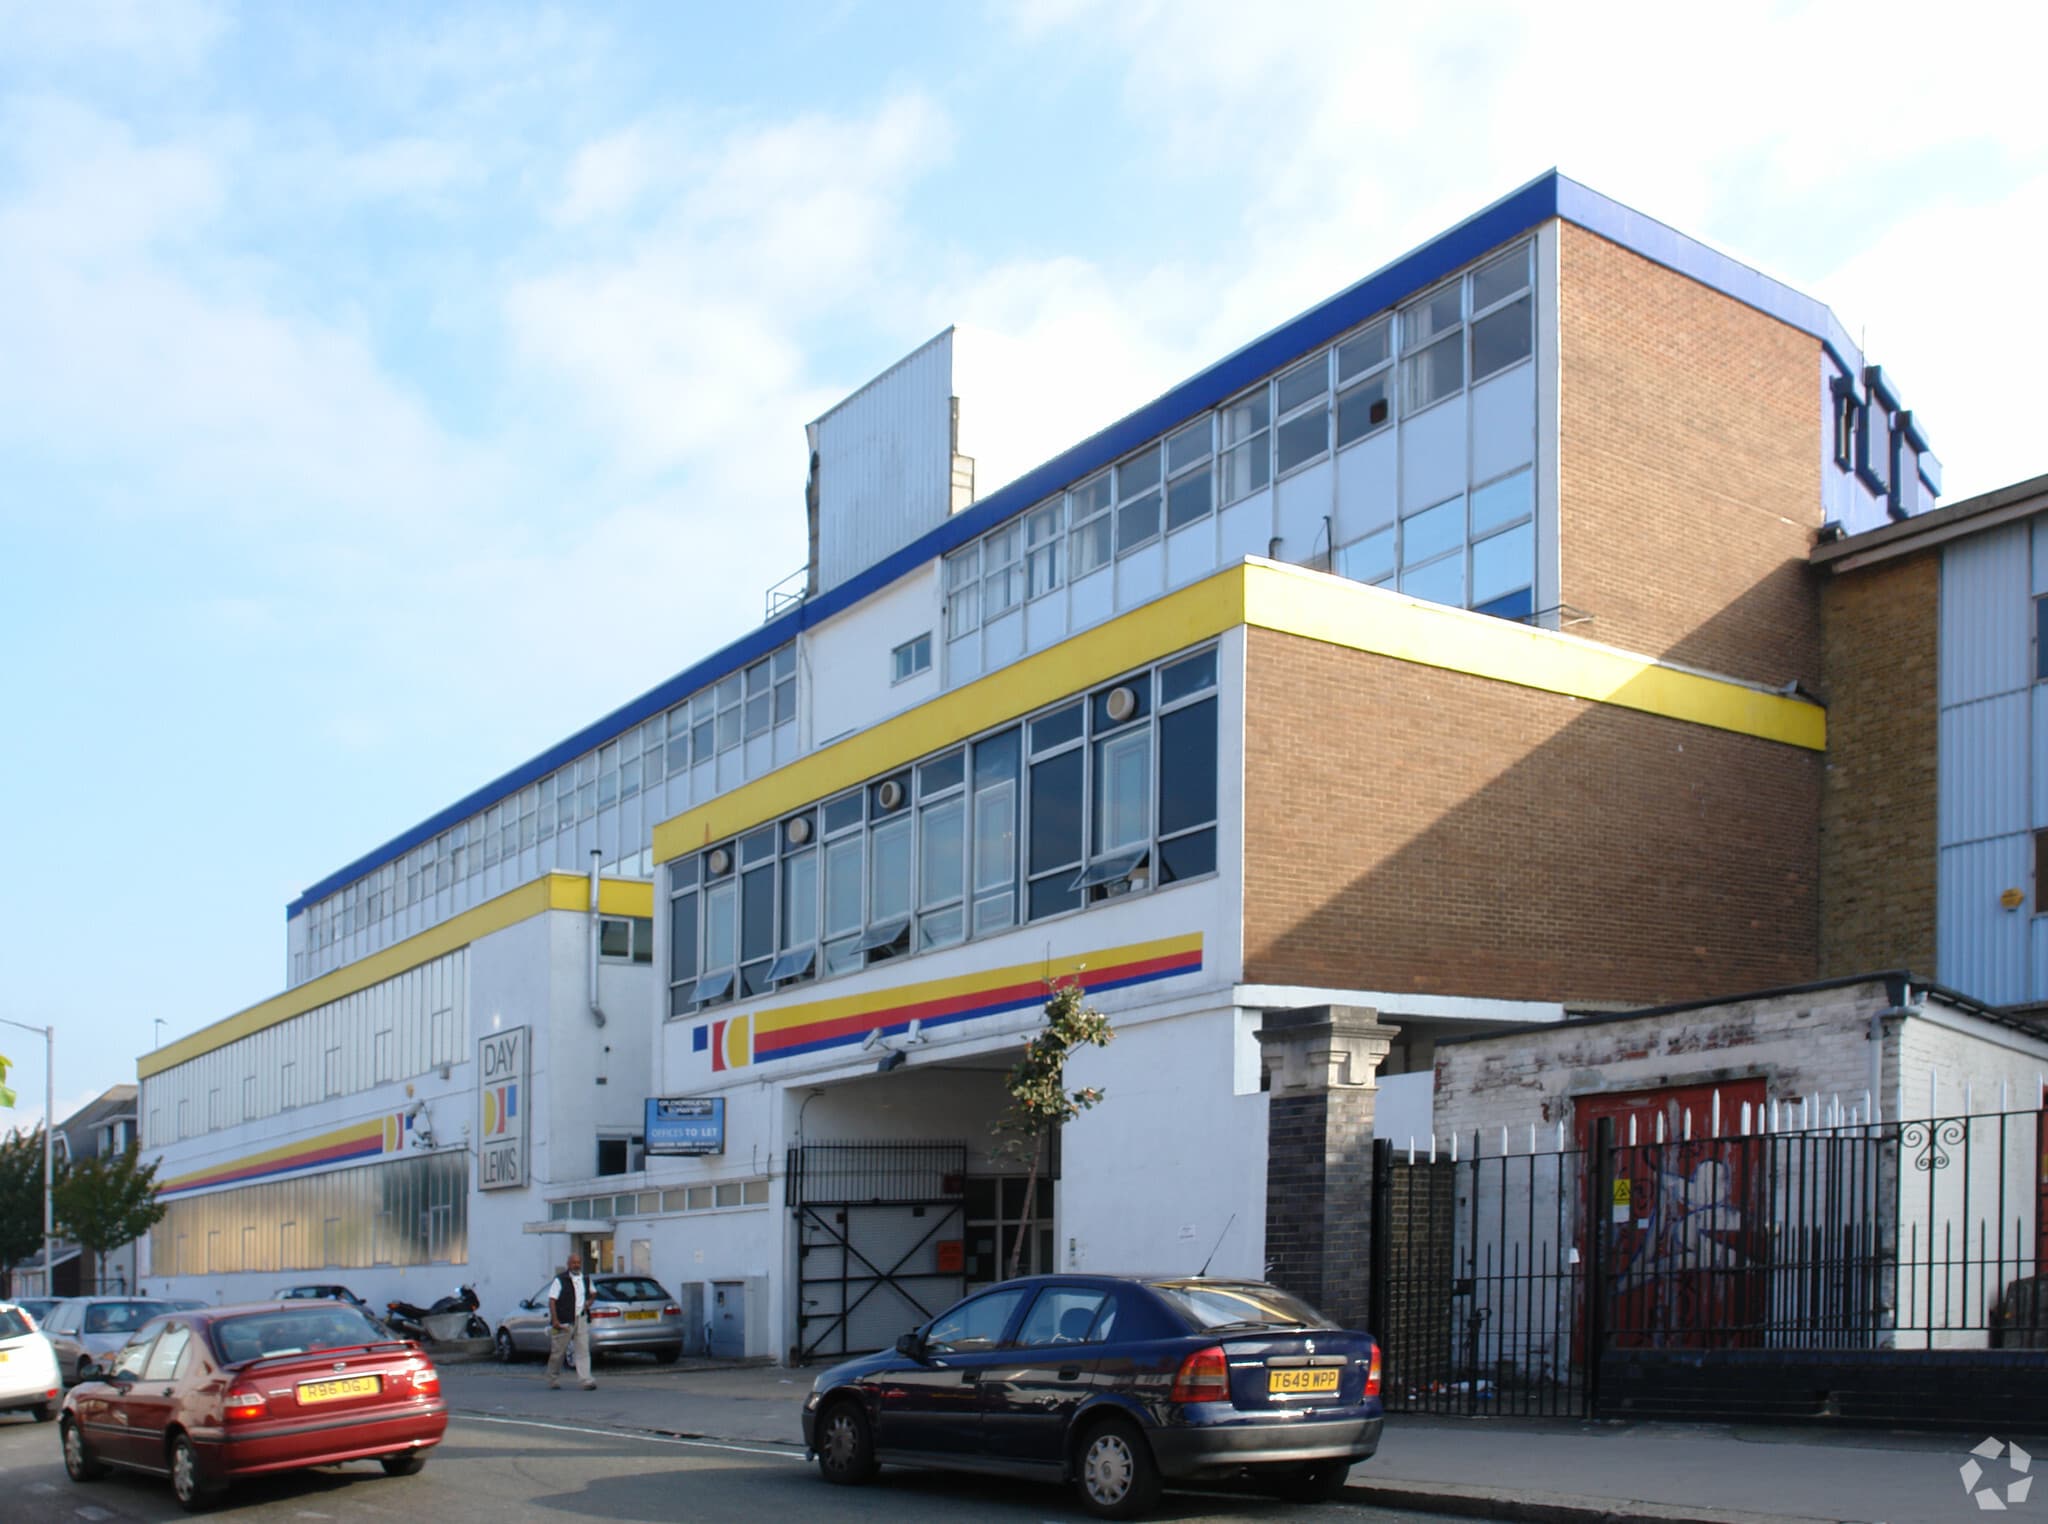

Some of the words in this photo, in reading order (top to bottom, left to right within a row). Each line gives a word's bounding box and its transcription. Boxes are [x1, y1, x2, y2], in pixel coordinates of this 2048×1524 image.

[484, 1034, 518, 1077] DAY
[684, 1127, 698, 1137] TO
[701, 1127, 718, 1137] LET
[483, 1147, 517, 1184] LEWIS
[1273, 1372, 1310, 1388] T649
[1313, 1371, 1336, 1387] WPP
[307, 1383, 337, 1398] R96
